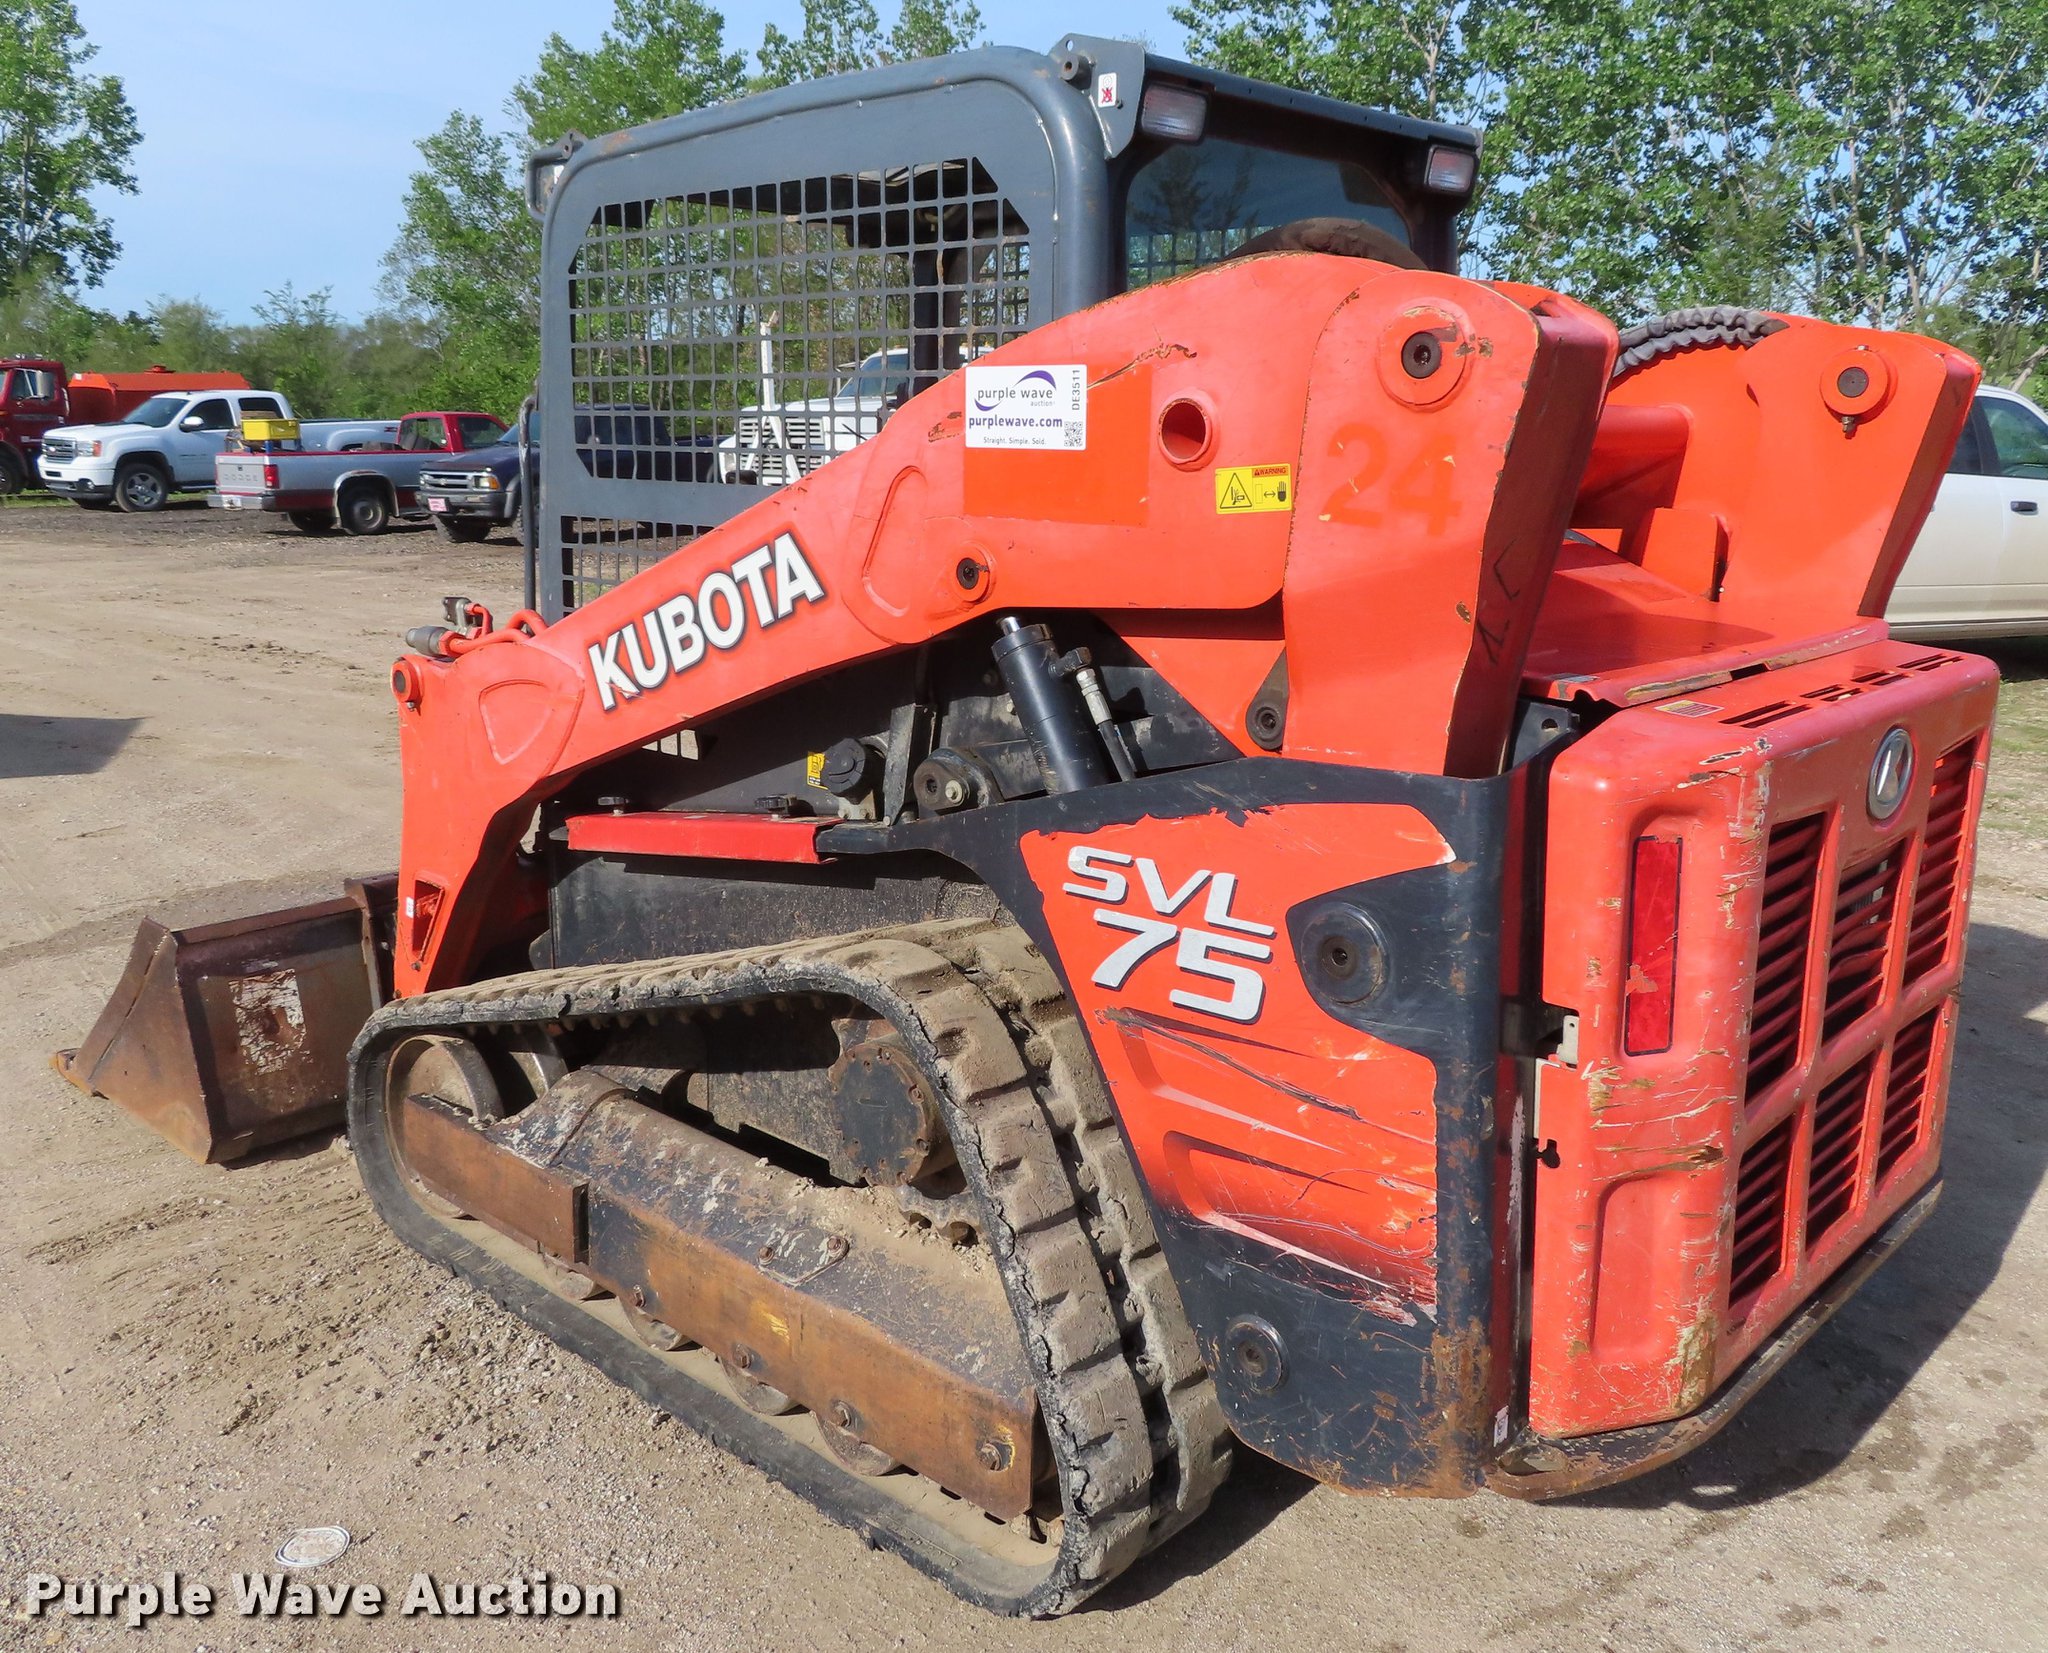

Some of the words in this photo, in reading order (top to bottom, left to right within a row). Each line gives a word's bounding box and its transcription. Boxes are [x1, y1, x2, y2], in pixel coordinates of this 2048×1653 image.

[968, 414, 1063, 429] purplewave.com
[977, 387, 1016, 401] purple
[1020, 388, 1053, 399] wave
[1072, 369, 1081, 411] DE3511
[983, 436, 1007, 446] Straight.
[1008, 436, 1030, 446] Simple.
[1032, 437, 1047, 446] Sold.
[1319, 423, 1463, 537] 24
[588, 532, 826, 711] KUBOTA
[1062, 845, 1276, 938] SVL
[1091, 908, 1273, 1023] 75
